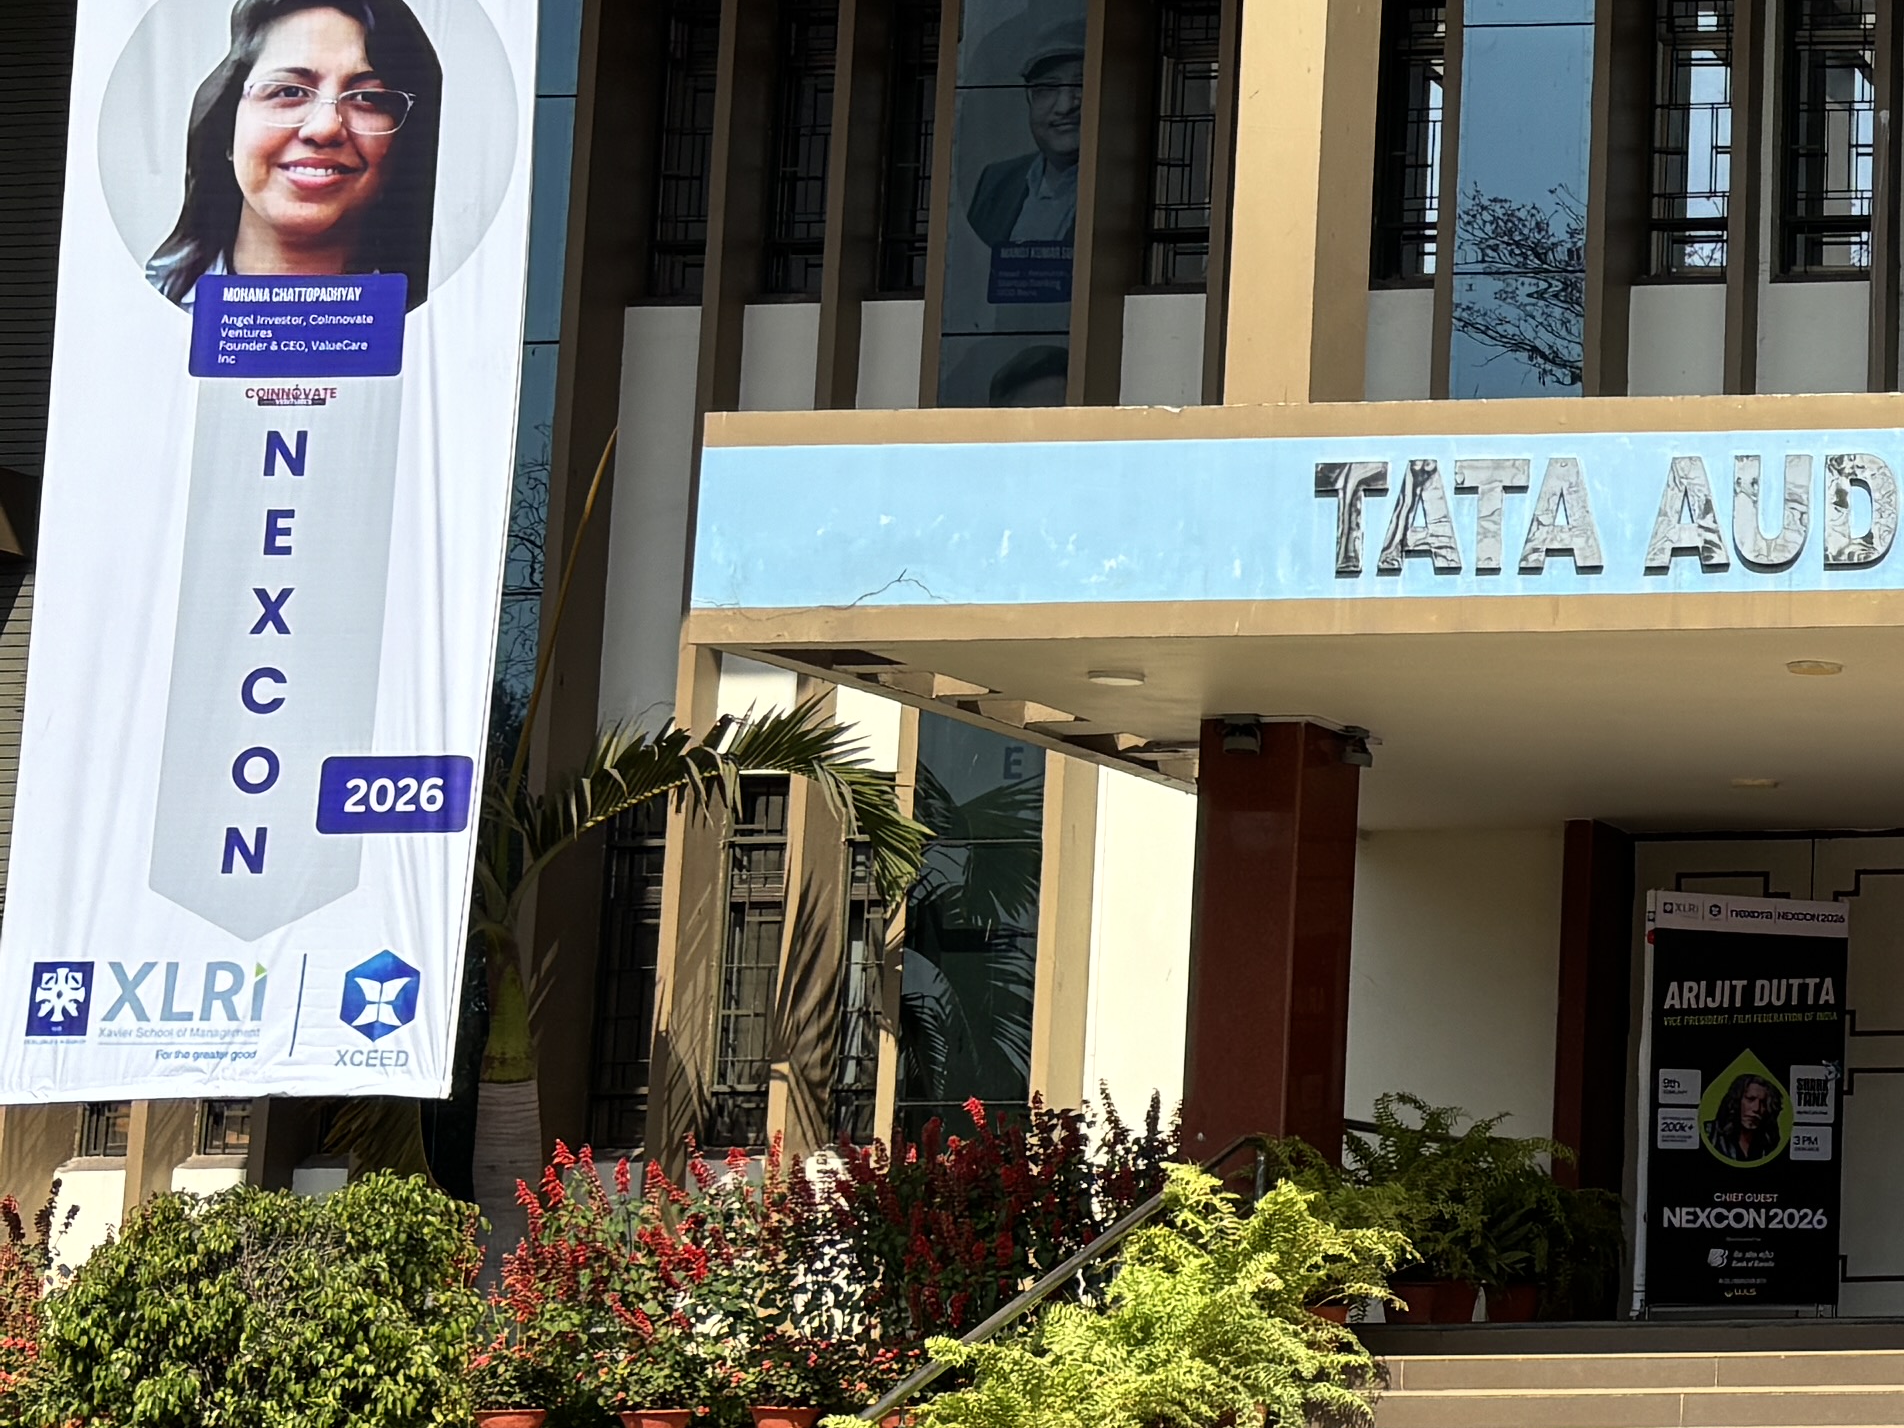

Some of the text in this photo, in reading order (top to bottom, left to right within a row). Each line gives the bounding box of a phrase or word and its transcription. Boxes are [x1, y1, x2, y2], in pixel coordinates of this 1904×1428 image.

[222, 286, 362, 302] MOHANA CHATTOPADHYAY
[221, 314, 254, 327] Angel
[220, 327, 273, 339] Ventures
[218, 339, 267, 351] Founder
[269, 340, 278, 351] &
[280, 339, 309, 352] CEO,
[217, 353, 236, 365] Inc
[1314, 456, 1604, 577] TATA
[220, 429, 309, 875] NEXCON
[342, 776, 445, 814] 2026
[1663, 977, 1836, 1009] ARIJIT DUTTA
[334, 1048, 410, 1068] XCEED
[1662, 1206, 1828, 1230] NEXCON 2026
